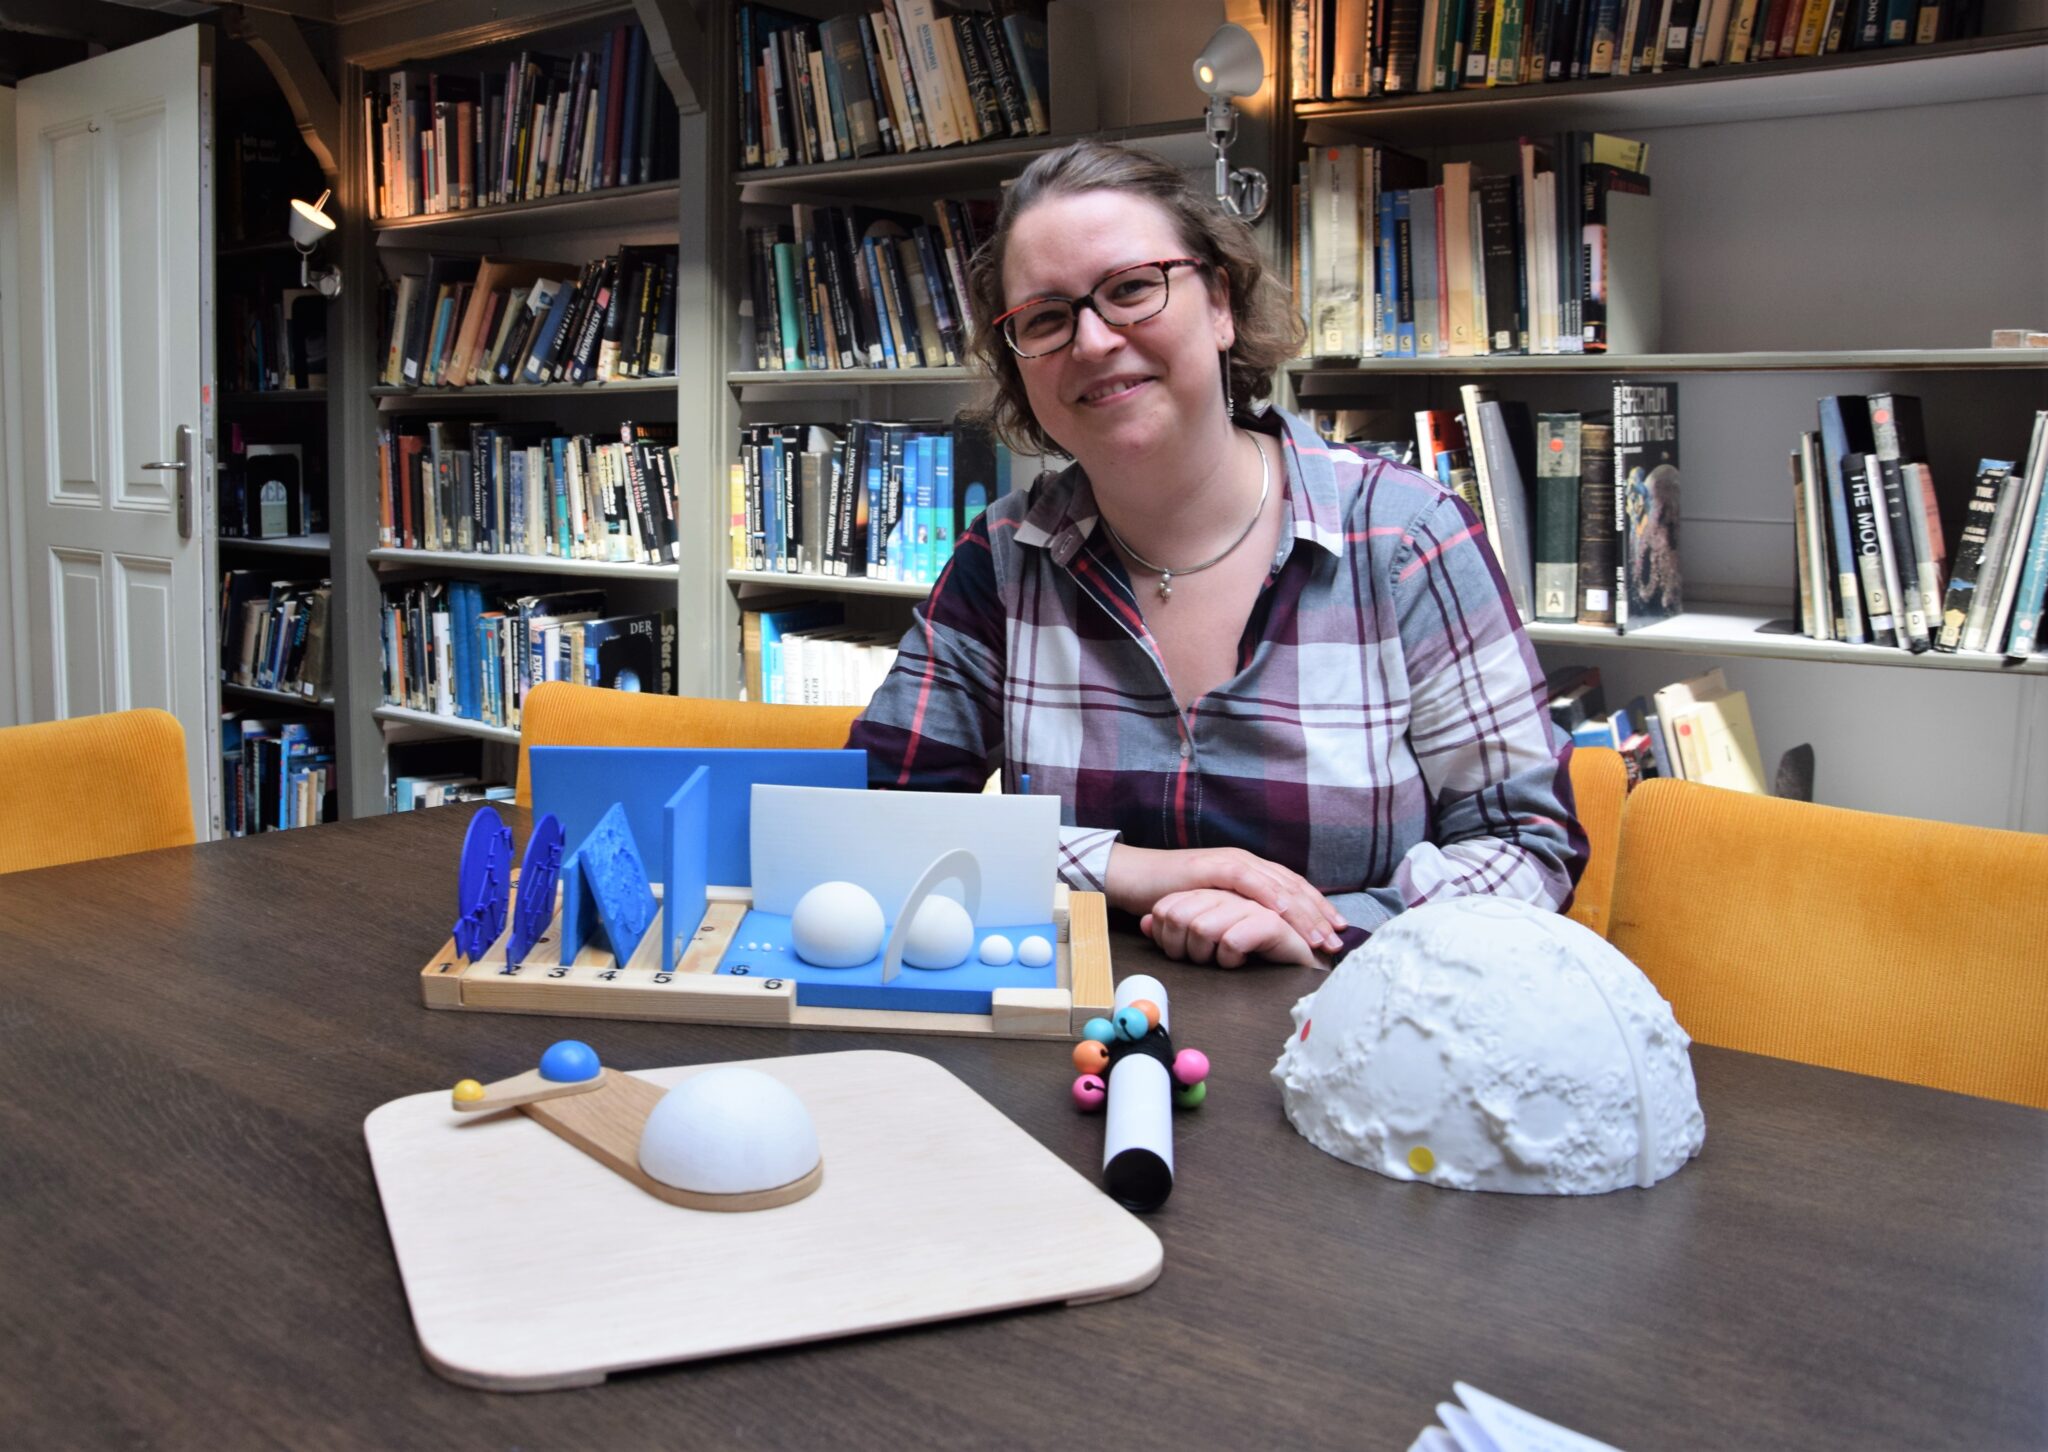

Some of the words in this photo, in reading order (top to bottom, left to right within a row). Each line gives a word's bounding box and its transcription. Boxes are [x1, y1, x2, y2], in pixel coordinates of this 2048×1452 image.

[958, 16, 983, 75] Astronomy
[981, 17, 1007, 77] Astronomy
[1596, 42, 1604, 54] C
[577, 310, 602, 365] ASTRONOMY
[1613, 387, 1622, 416] PATRICK
[1614, 416, 1622, 444] MOORE
[785, 451, 794, 500] Contemporary
[845, 448, 857, 493] UNFOLDING
[1614, 446, 1623, 486] SPECTRUM
[473, 467, 482, 522] Astronomy
[633, 486, 644, 514] VISION
[636, 468, 650, 511] HUBBLE
[829, 464, 841, 515] INTRODUCTORY
[844, 493, 853, 511] OUR
[1849, 472, 1871, 508] THE
[480, 488, 489, 529] Astronomy
[786, 501, 795, 540] Astronomy
[1615, 486, 1624, 532] MAANATLAS
[825, 515, 834, 557] ASTRONOMY
[840, 511, 852, 547] UNIVERSE
[1857, 512, 1880, 569] MOON
[1616, 566, 1624, 581] HET
[1549, 593, 1560, 607] A
[1873, 592, 1881, 603] D
[1923, 594, 1931, 606] D
[630, 620, 652, 636] DER
[1911, 614, 1920, 625] D
[661, 624, 676, 669] Stars
[499, 964, 522, 976] 2
[548, 967, 569, 979] 3
[597, 970, 617, 982] 4
[653, 972, 673, 985] 5
[764, 978, 784, 990] 6
